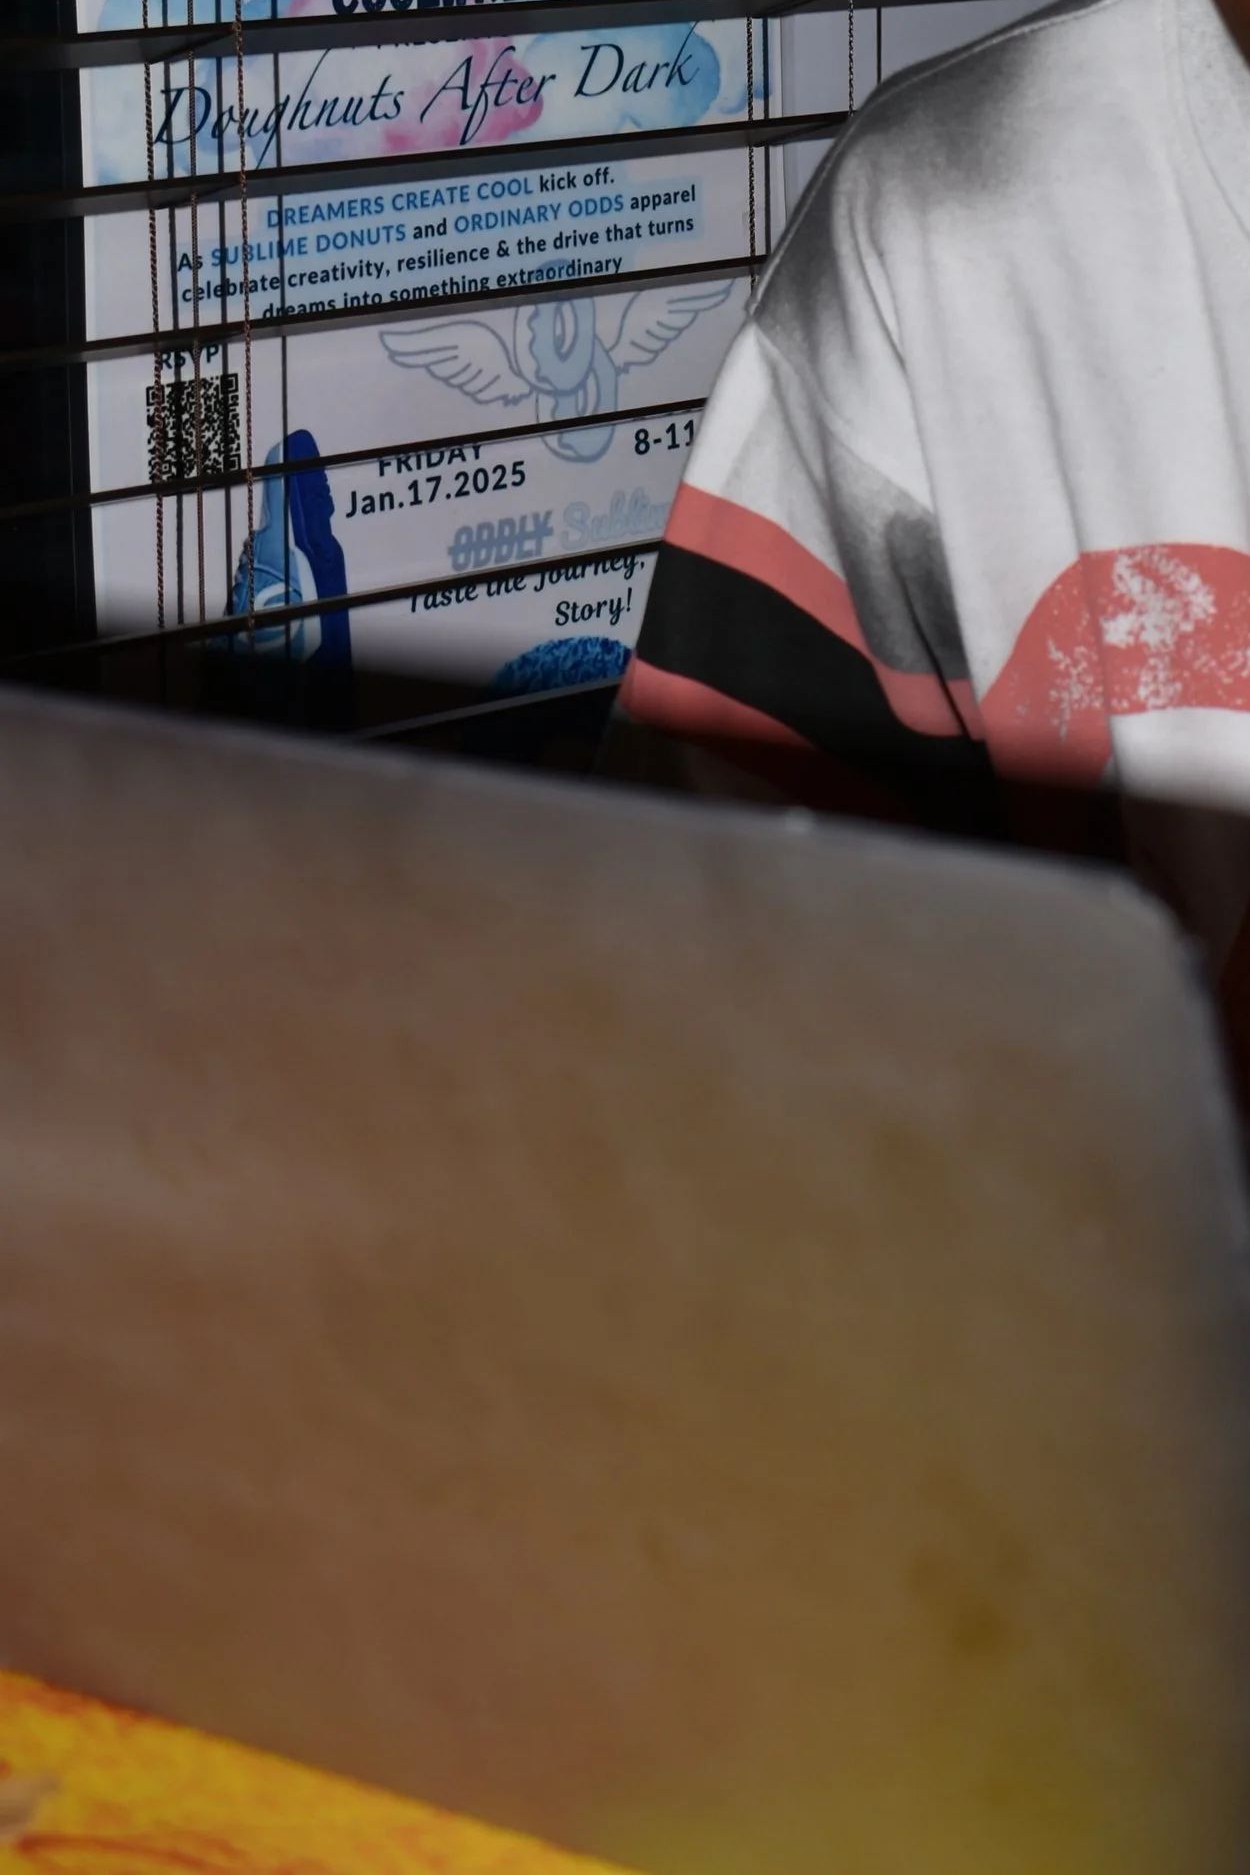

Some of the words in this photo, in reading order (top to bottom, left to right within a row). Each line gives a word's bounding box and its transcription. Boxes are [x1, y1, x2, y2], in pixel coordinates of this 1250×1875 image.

[153, 48, 405, 170] Doughnuts
[420, 46, 556, 146] After
[574, 21, 700, 98] Dark
[177, 253, 203, 272] As
[211, 237, 308, 267] SUBLIME
[316, 224, 406, 253] DONUTS
[413, 218, 447, 240] and
[454, 203, 561, 234] ORDINARY
[568, 194, 624, 218] ODDS
[630, 184, 696, 211] apparel
[267, 196, 384, 229] DREAMERS
[391, 184, 470, 211] CREATE
[477, 177, 533, 201] COOL
[540, 172, 577, 193] kick
[583, 167, 615, 187] off.
[181, 275, 281, 302] celebrate
[287, 258, 391, 287] creativity,
[397, 244, 490, 272] resilience
[496, 240, 510, 258] &
[517, 237, 547, 255] the
[553, 229, 600, 250] drive
[605, 221, 642, 242] that
[648, 216, 694, 237] turns
[262, 299, 336, 319] dreams
[343, 292, 382, 309] into
[389, 272, 490, 303] something
[496, 257, 623, 288] extraordinary
[345, 461, 526, 518] Jan.17.2025
[378, 443, 483, 477] FRIDAY
[555, 587, 633, 626] Story!
